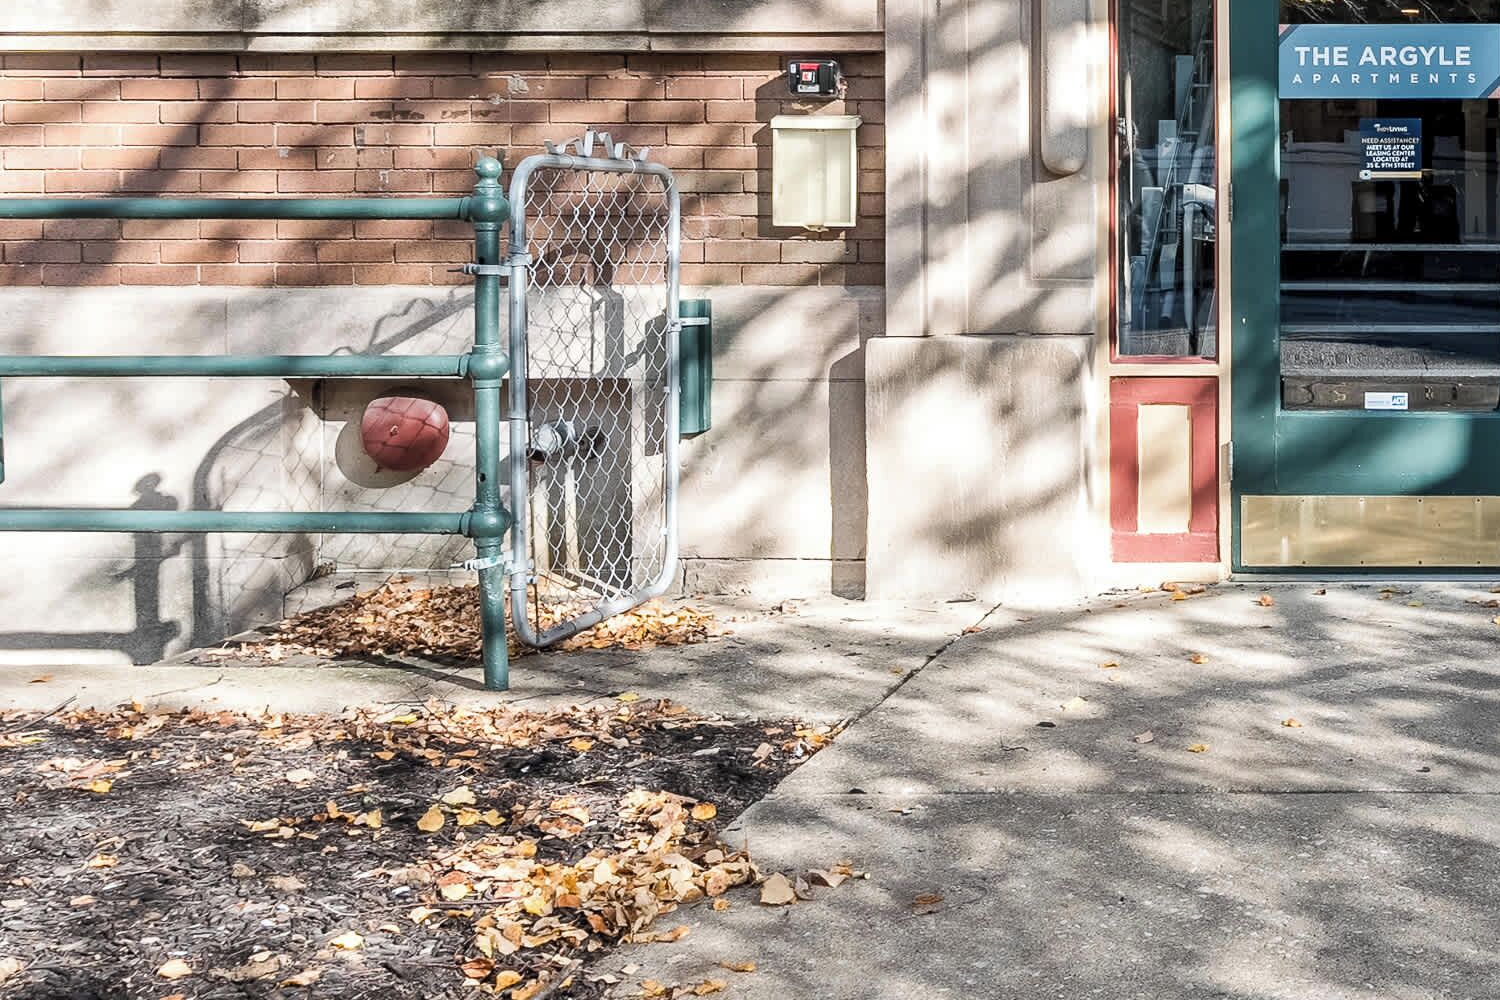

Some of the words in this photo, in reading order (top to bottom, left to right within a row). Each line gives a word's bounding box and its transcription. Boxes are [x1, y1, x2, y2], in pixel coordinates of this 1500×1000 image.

[1295, 46, 1349, 67] THE
[1359, 46, 1472, 67] ARGYLE
[1292, 73, 1477, 84] APARTMENTS
